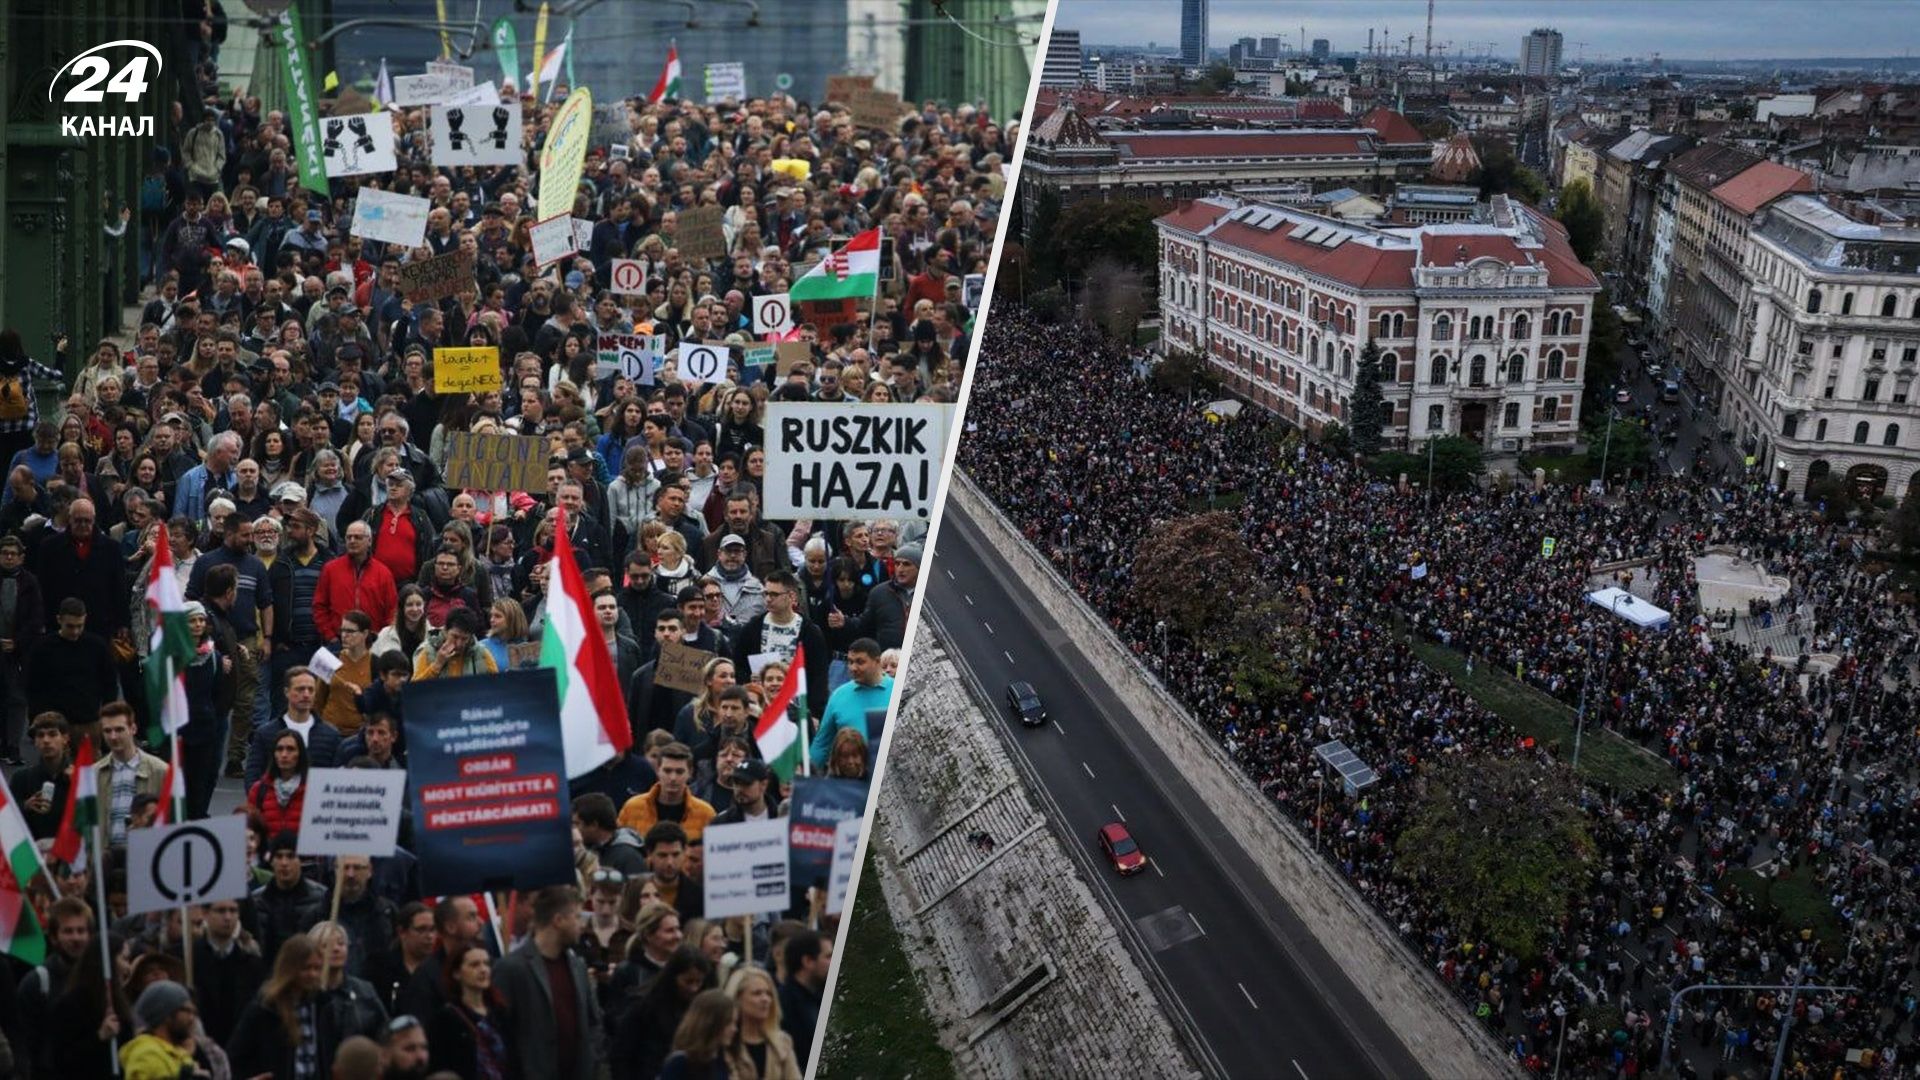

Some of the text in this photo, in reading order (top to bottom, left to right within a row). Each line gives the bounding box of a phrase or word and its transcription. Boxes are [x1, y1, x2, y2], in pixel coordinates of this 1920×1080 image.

[599, 335, 645, 351] NEKEM
[782, 415, 927, 454] RUSZKIK
[791, 459, 929, 518] HAZA!
[463, 758, 511, 773] ORBÁN
[424, 787, 464, 803] MOST
[544, 778, 554, 790] A
[431, 803, 552, 826] PÉNZTÁRCÁNKAT!
